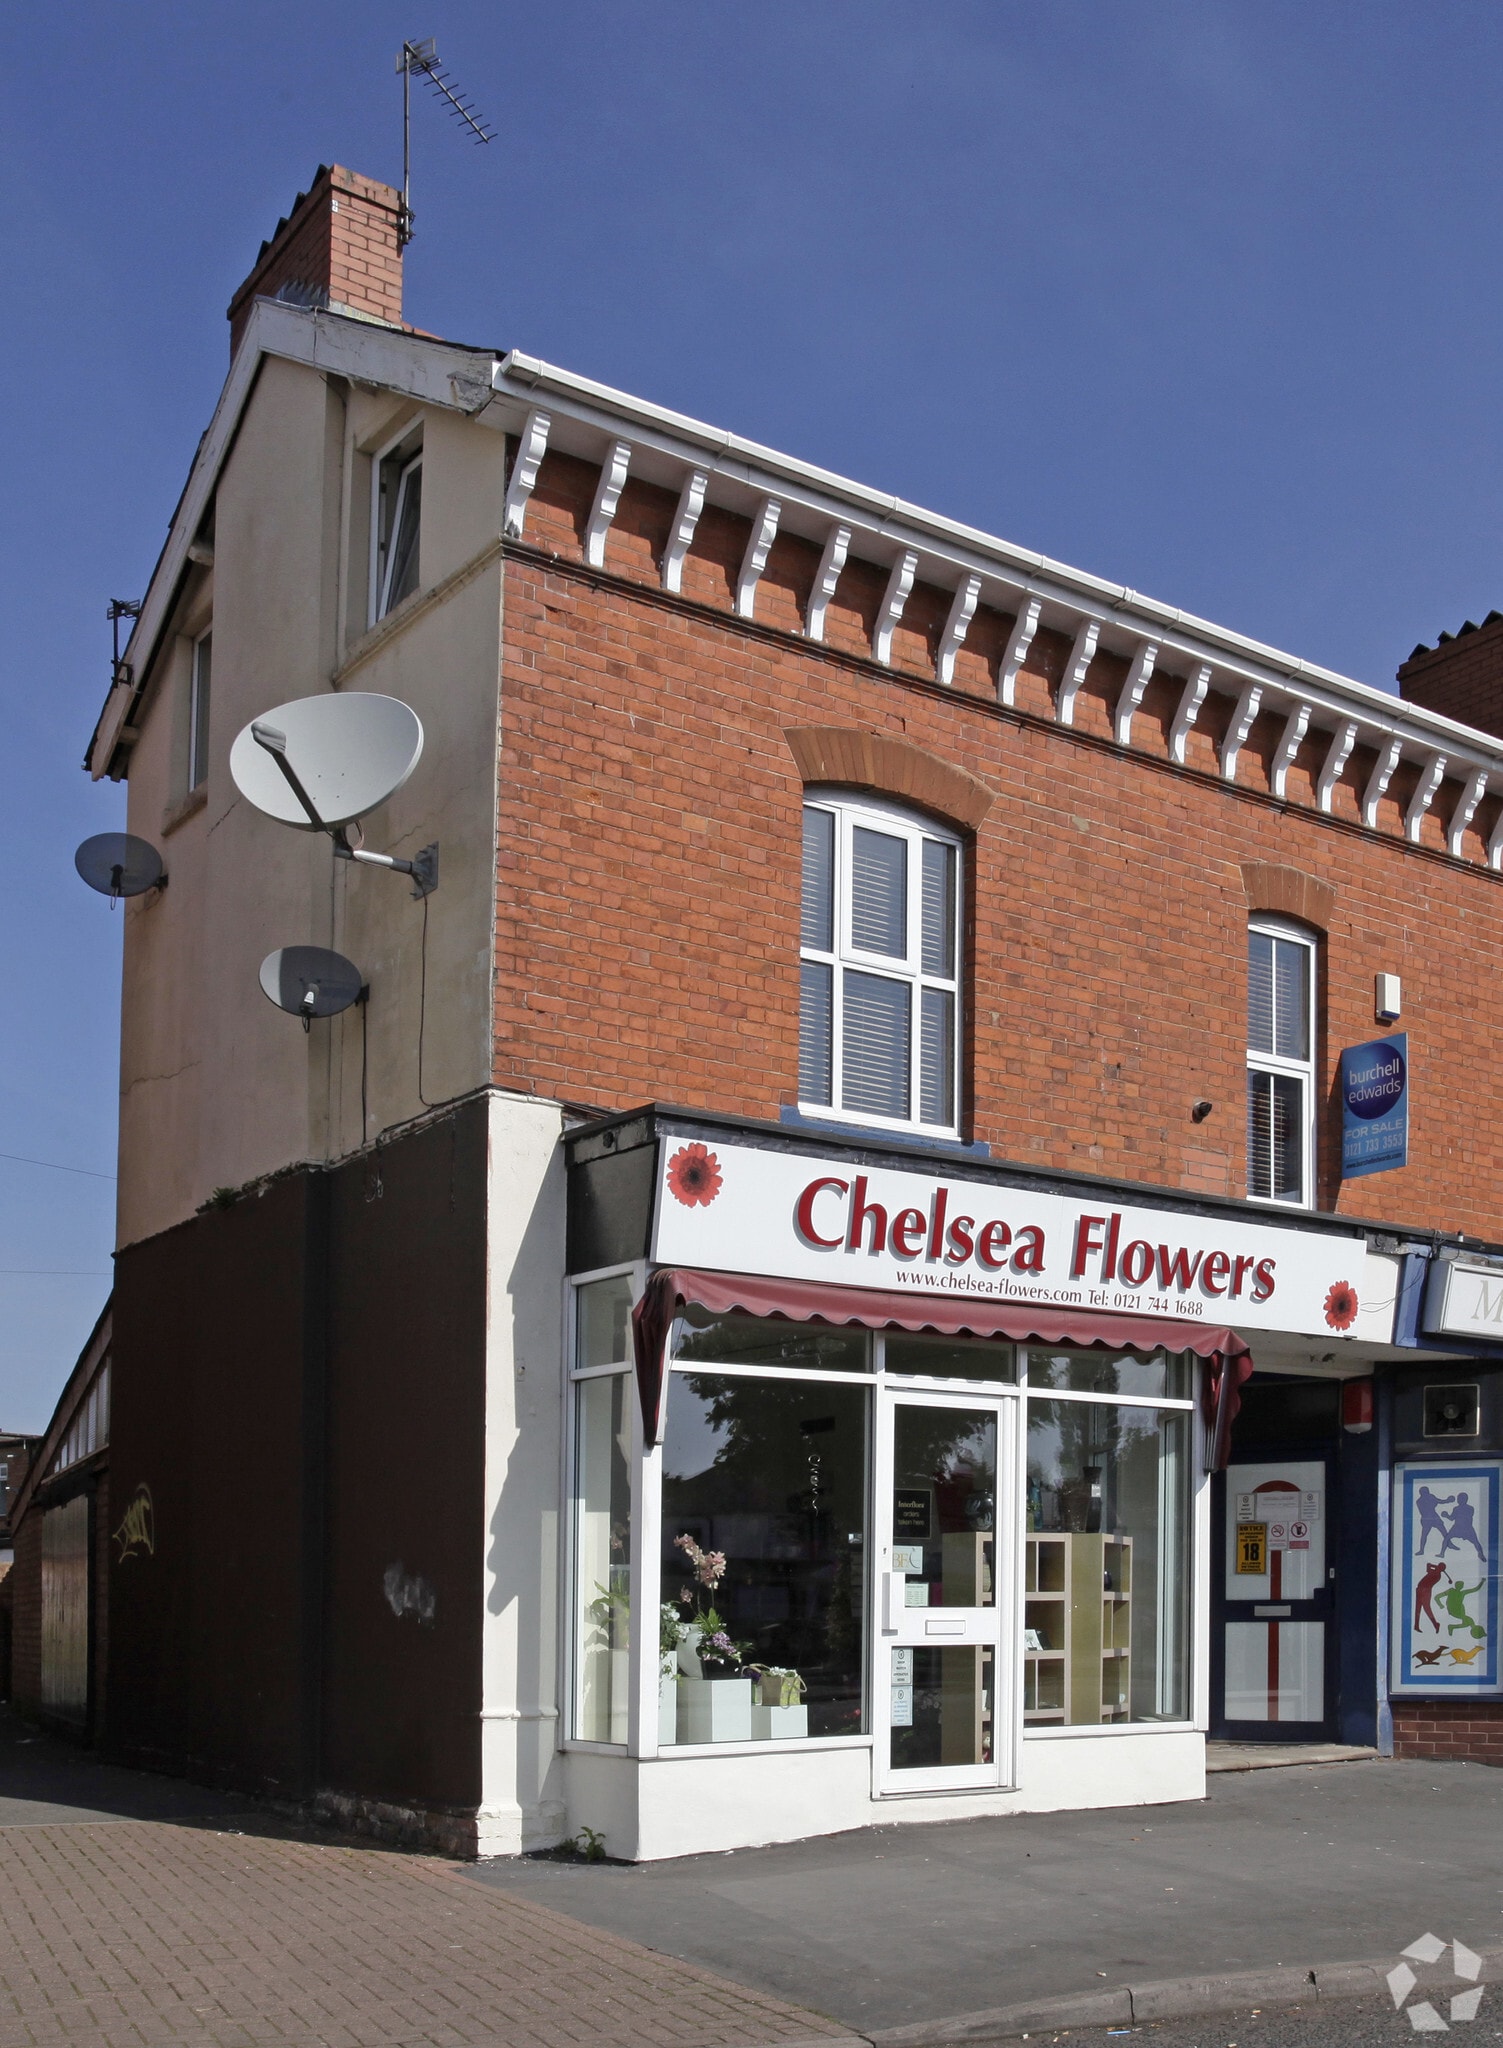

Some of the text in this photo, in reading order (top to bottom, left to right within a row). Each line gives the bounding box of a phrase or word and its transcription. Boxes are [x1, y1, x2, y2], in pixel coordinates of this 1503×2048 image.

[1349, 1058, 1400, 1086] burchell
[1348, 1078, 1401, 1104] edwards
[1345, 1118, 1403, 1140] FOR SALE
[1344, 1142, 1361, 1157] 0121
[794, 1175, 1277, 1301] Chelsea Flowers
[896, 1270, 1204, 1316] www.chelsea-flowers.com Tel: 0121 744 1688
[1243, 1543, 1260, 1561] 18
